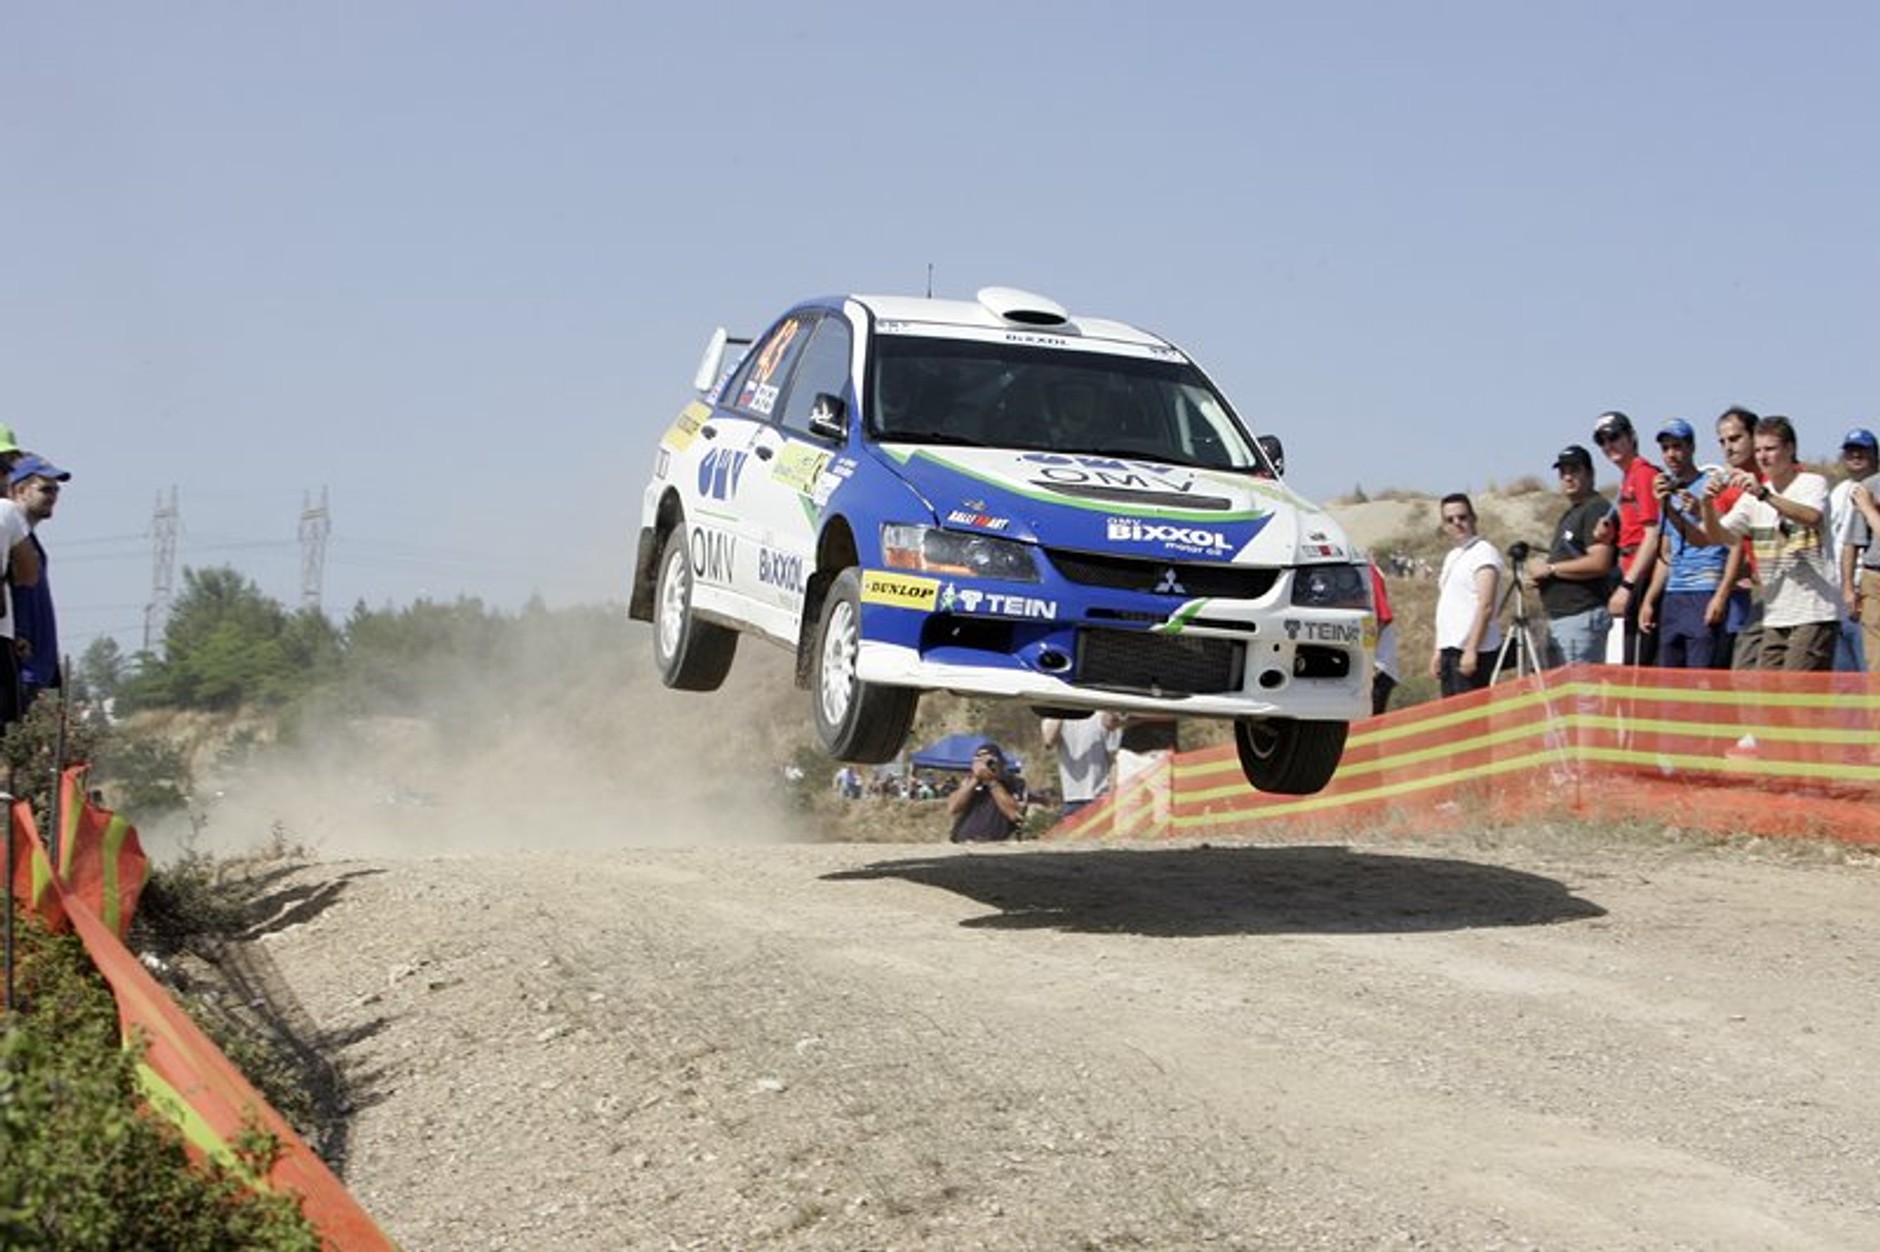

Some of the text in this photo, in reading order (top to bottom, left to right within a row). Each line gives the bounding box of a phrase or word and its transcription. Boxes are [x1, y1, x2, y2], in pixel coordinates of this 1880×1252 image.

[1041, 467, 1193, 492] OMV
[691, 526, 737, 584] OMV
[870, 581, 935, 599] DUNLOP
[986, 593, 1057, 620] TEIN
